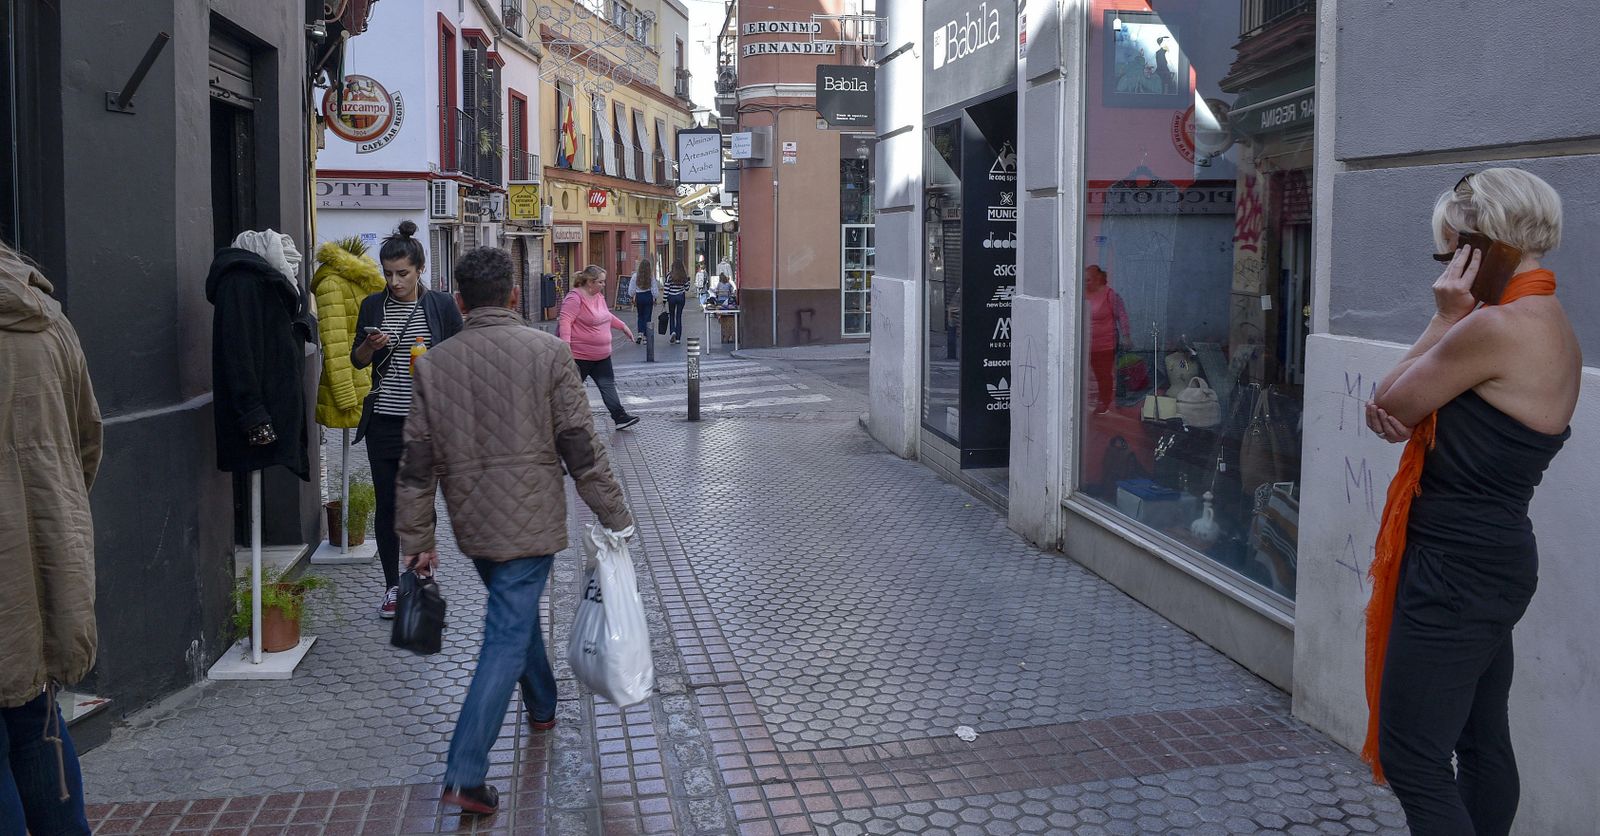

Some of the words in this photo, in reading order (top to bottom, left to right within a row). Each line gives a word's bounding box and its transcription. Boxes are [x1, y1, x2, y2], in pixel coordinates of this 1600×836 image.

[947, 2, 1000, 64] Babila
[824, 76, 868, 91] Babila
[329, 102, 386, 113] Cuzcampo
[383, 128, 397, 142] BAR
[393, 95, 403, 127] REGINA
[995, 174, 1006, 182] coq
[590, 192, 605, 206] illy
